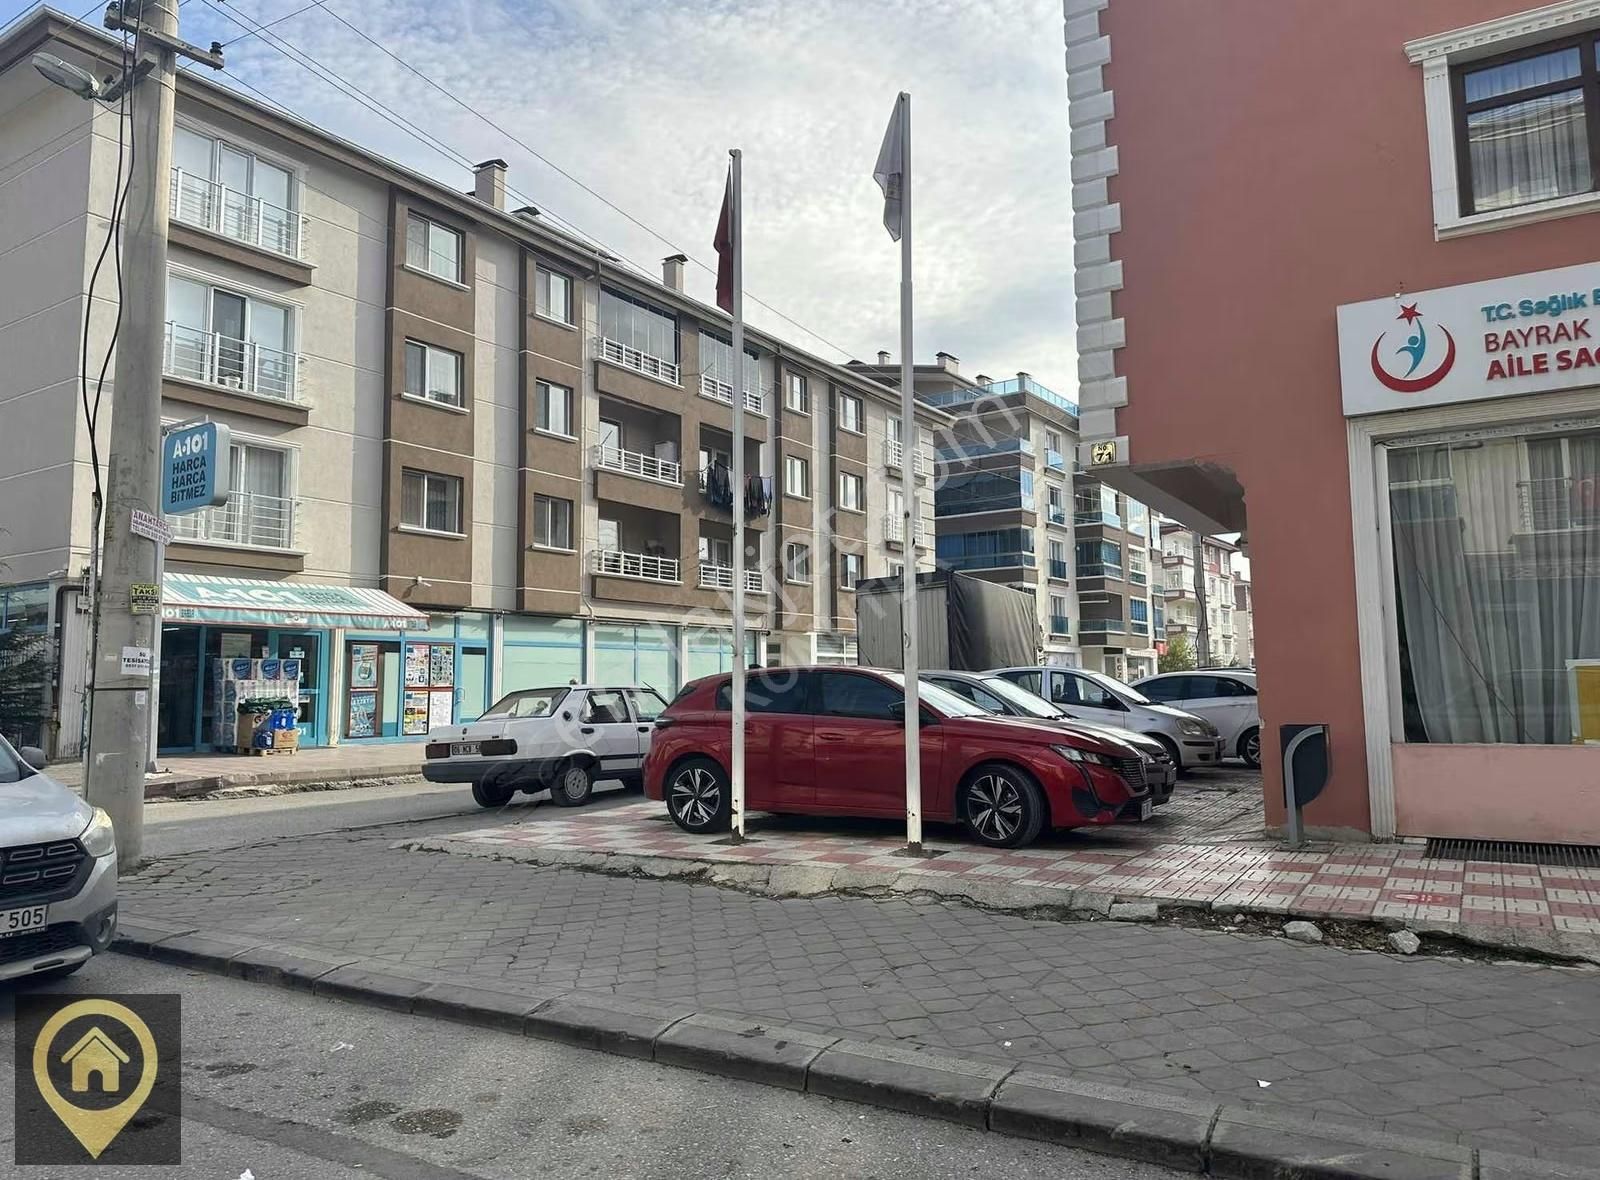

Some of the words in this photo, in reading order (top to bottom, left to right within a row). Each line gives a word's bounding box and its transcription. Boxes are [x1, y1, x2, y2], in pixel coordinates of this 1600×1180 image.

[1481, 303, 1516, 322] T.C.
[1518, 291, 1588, 317] Sağlık
[1484, 318, 1592, 353] BAYRAK
[1486, 353, 1549, 380] AİLE
[172, 456, 207, 475] HARCA
[1096, 452, 1112, 462] 71
[171, 470, 206, 490] HARCA
[170, 484, 206, 504] BİTMEZ
[9, 907, 44, 928] 505
